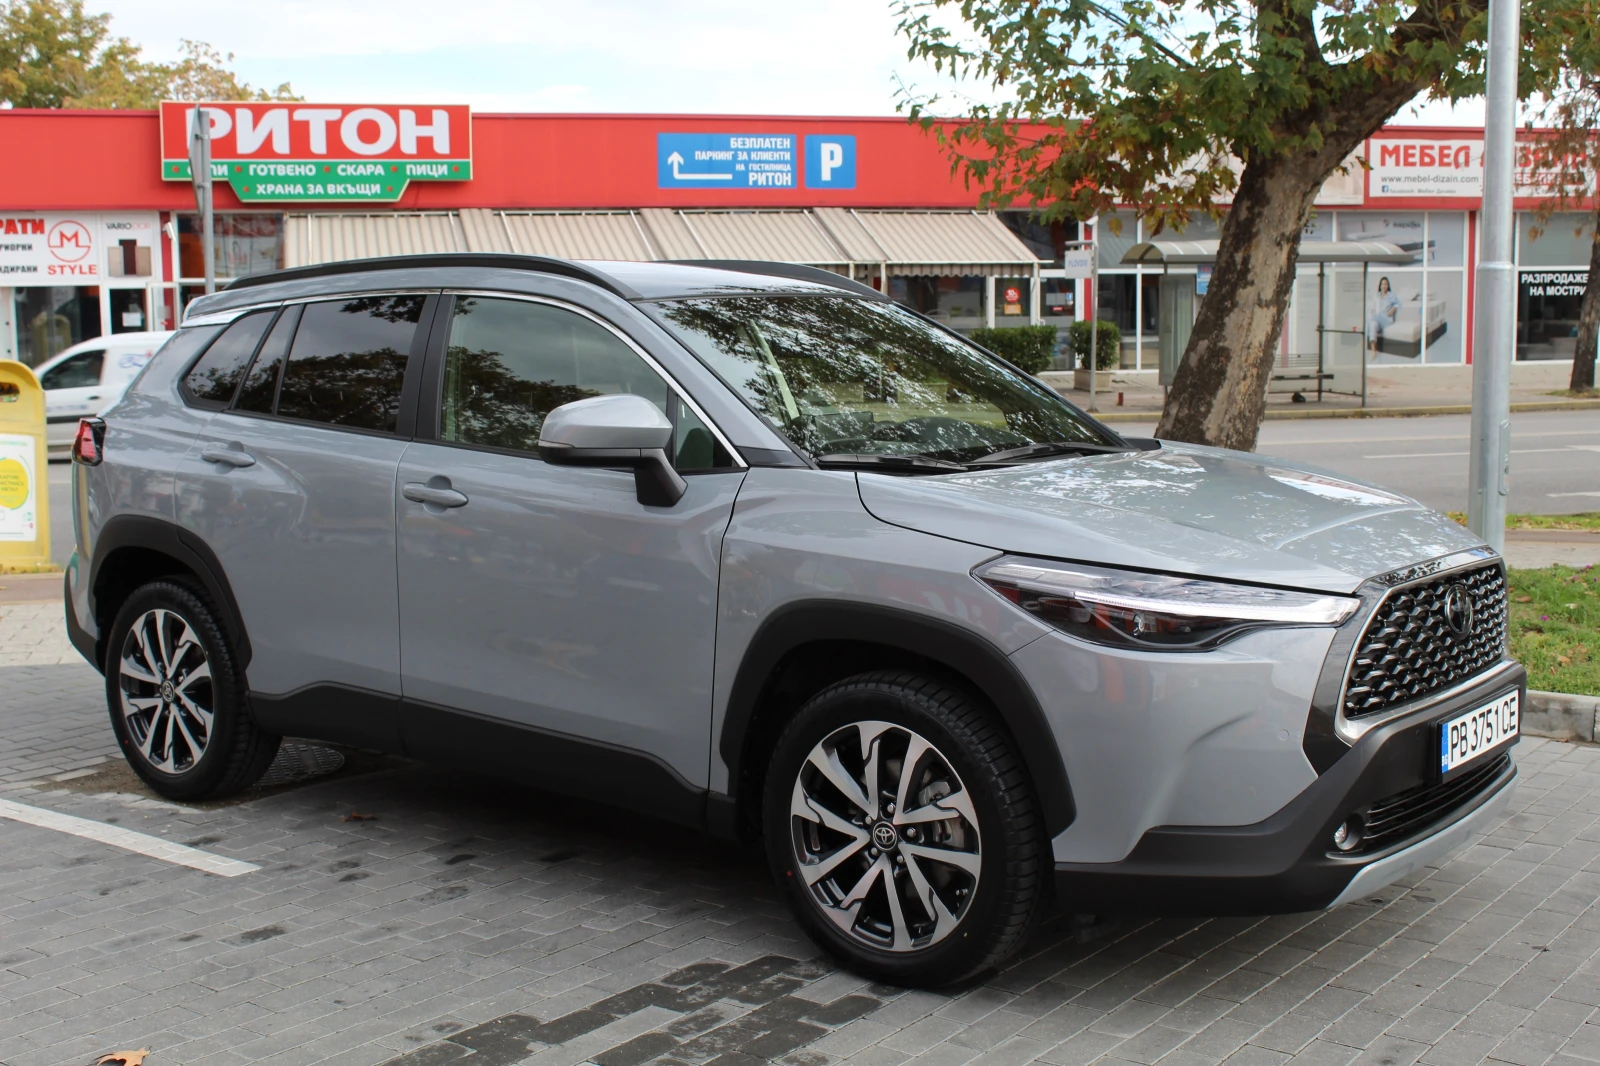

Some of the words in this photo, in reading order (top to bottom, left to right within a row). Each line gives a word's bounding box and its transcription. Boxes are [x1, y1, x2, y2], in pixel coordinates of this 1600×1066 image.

[186, 107, 450, 156] РИТОН
[730, 137, 791, 149] БЕЗПЛАТЕН
[695, 151, 734, 161] ПАРКИНГ
[737, 151, 748, 161] ЗА
[751, 151, 791, 161] КЛИЕНТИ
[820, 142, 843, 181] P
[1380, 145, 1470, 169] МЕБЕЛ
[187, 164, 229, 176] ПИ
[249, 164, 317, 176] ГОТВЕНО
[337, 164, 385, 176] СКАРА
[406, 164, 448, 178] ПИЦИ
[736, 163, 745, 171] НА
[749, 163, 792, 172] ГОСТИЛНИЦА
[749, 172, 792, 186] РИТОН
[1381, 175, 1479, 184] www.mebel-dizain.com
[256, 184, 304, 195] ХРАНА
[307, 184, 324, 195] ЗА
[327, 184, 381, 196] ВКЪЩИ
[48, 265, 97, 275] STYLE
[1529, 286, 1544, 296] НА
[1451, 721, 1467, 762] PB
[1471, 705, 1498, 751] 3751
[1502, 697, 1516, 734] CE
